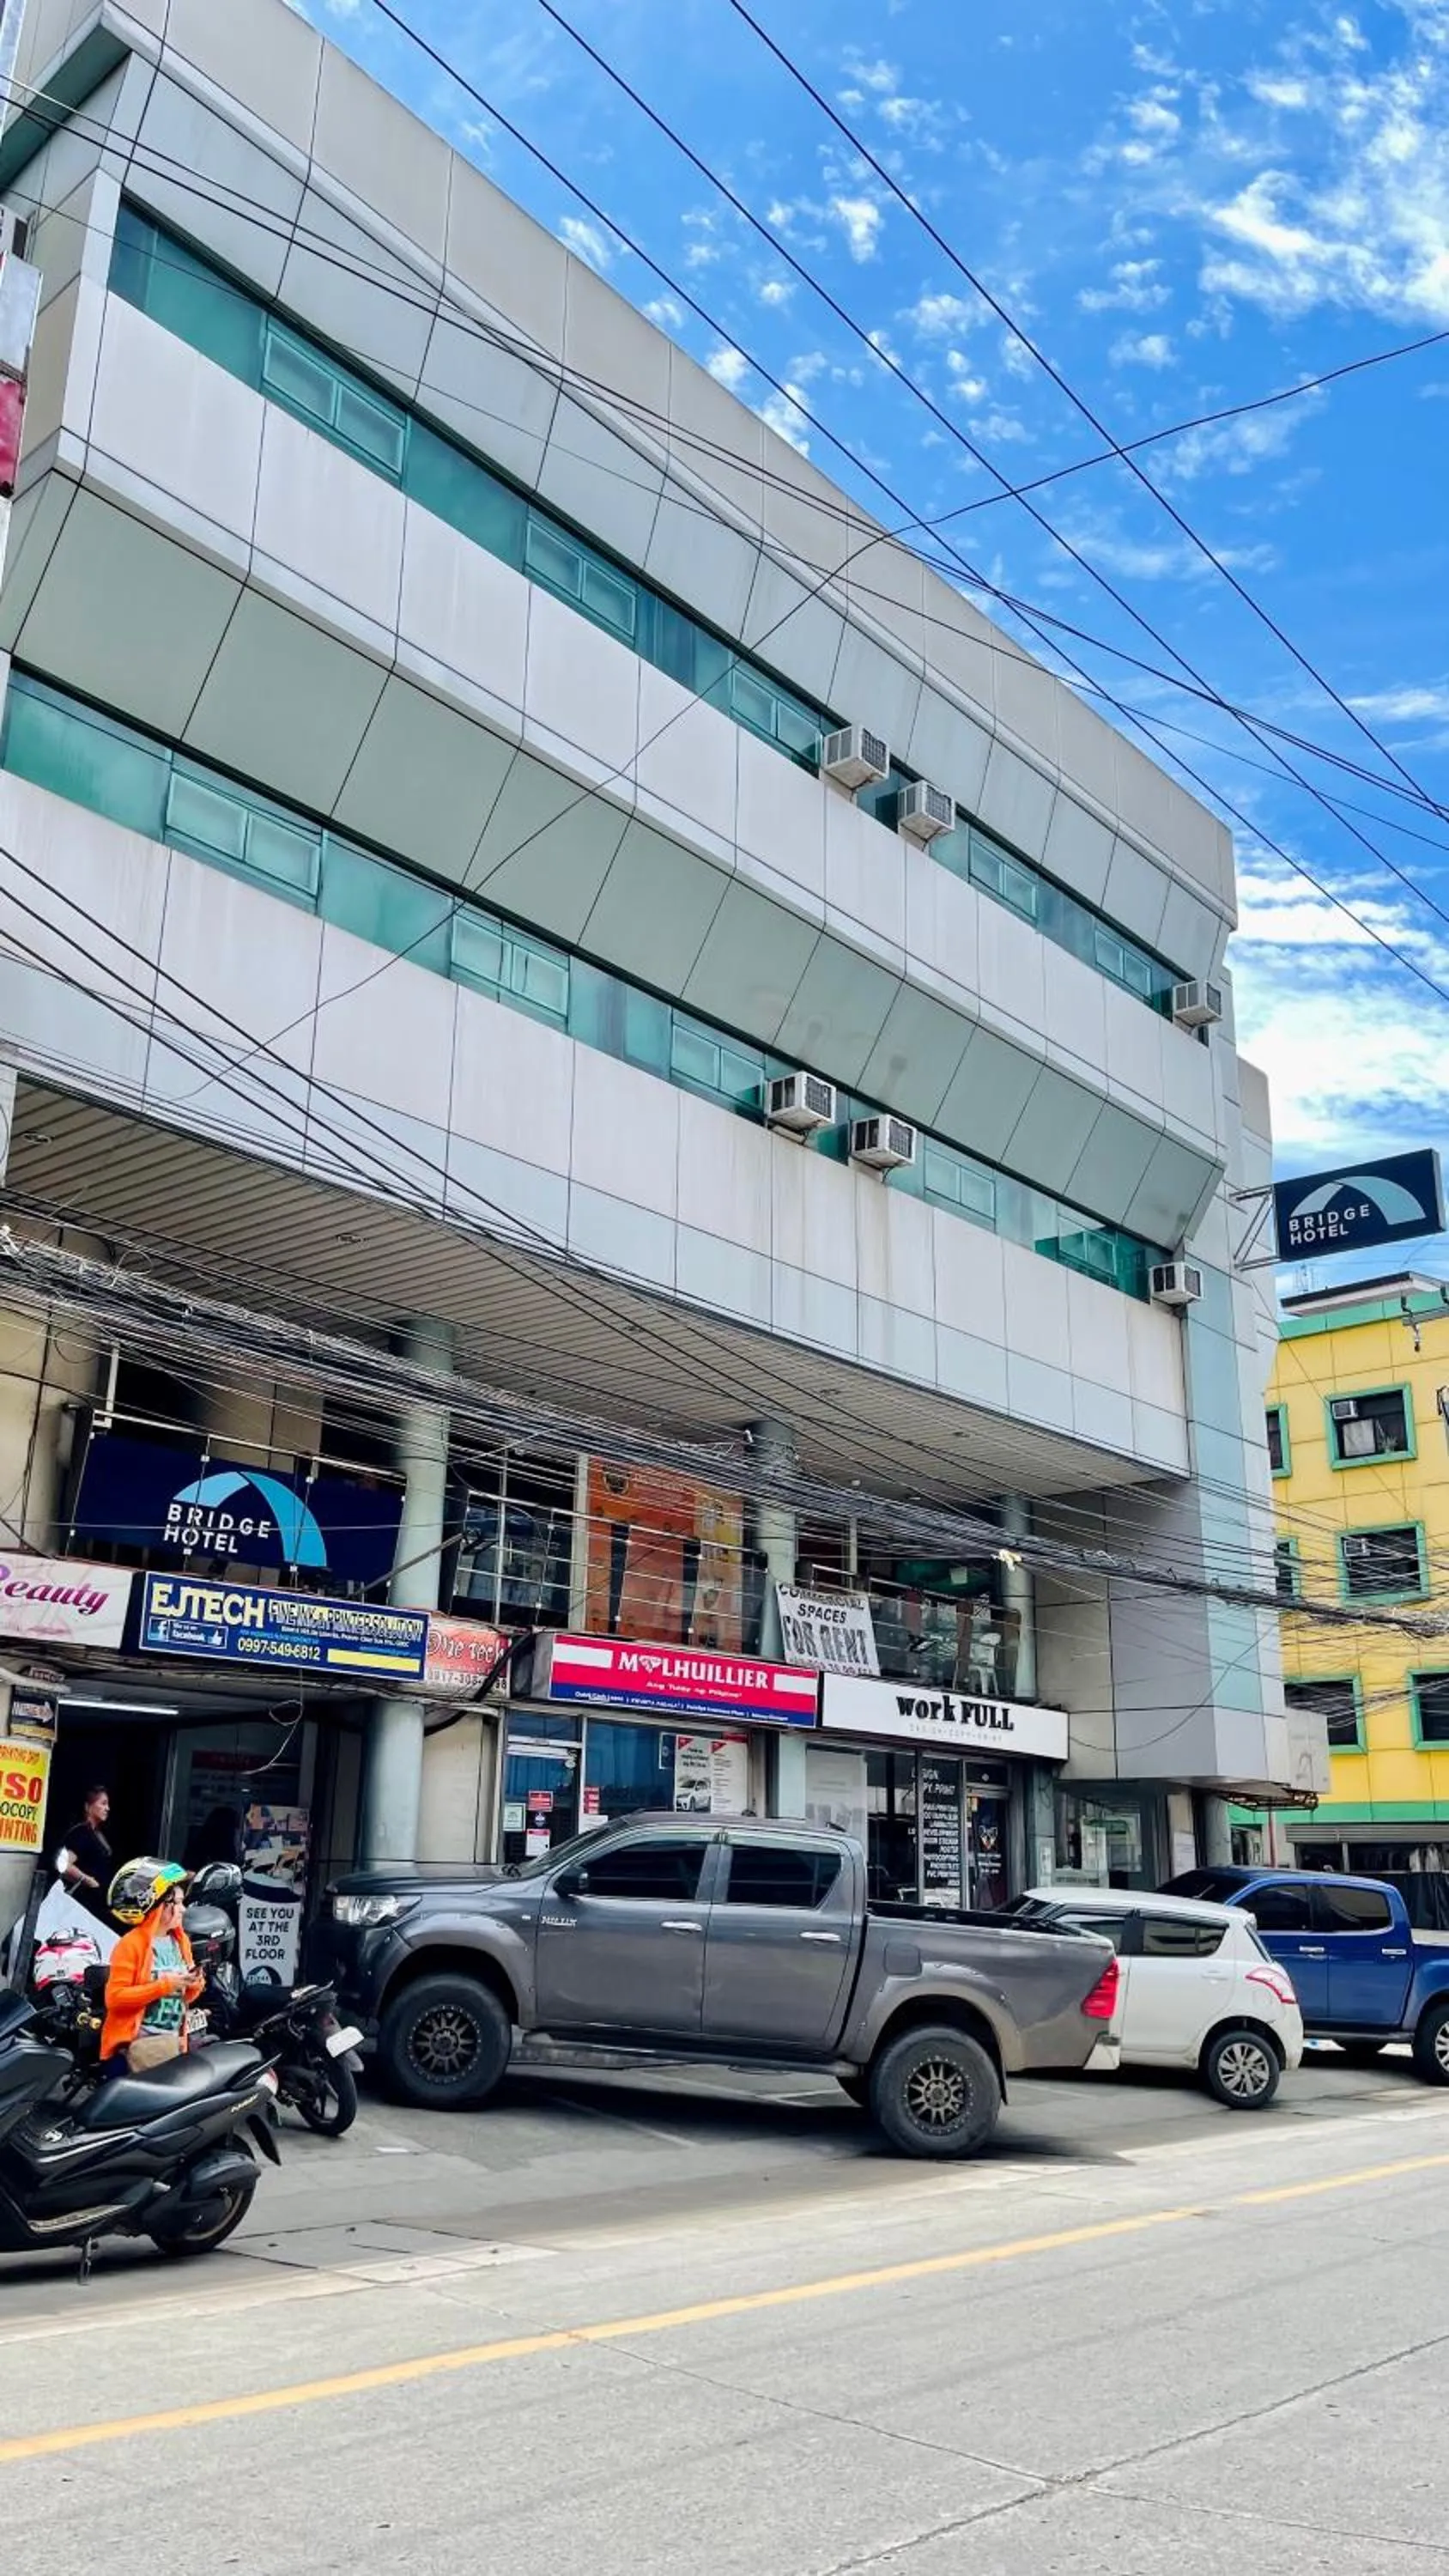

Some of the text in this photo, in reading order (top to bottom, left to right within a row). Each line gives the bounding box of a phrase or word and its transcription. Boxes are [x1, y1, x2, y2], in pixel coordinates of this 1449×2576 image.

[1289, 1204, 1370, 1232] BRIDGE
[1290, 1223, 1349, 1246] HOTEL
[167, 1504, 271, 1539] BRIDGE
[163, 1524, 238, 1553] HOTEL
[150, 1582, 265, 1629] EJTECH
[797, 1603, 847, 1624] SPACES
[783, 1615, 869, 1665] FOR RENT
[896, 1695, 1015, 1731] work FULL
[246, 1907, 294, 1920] SEE YOU
[249, 1922, 289, 1933] AT THE
[256, 1935, 281, 1947] 3RD
[245, 1948, 285, 1960] FLOOR
